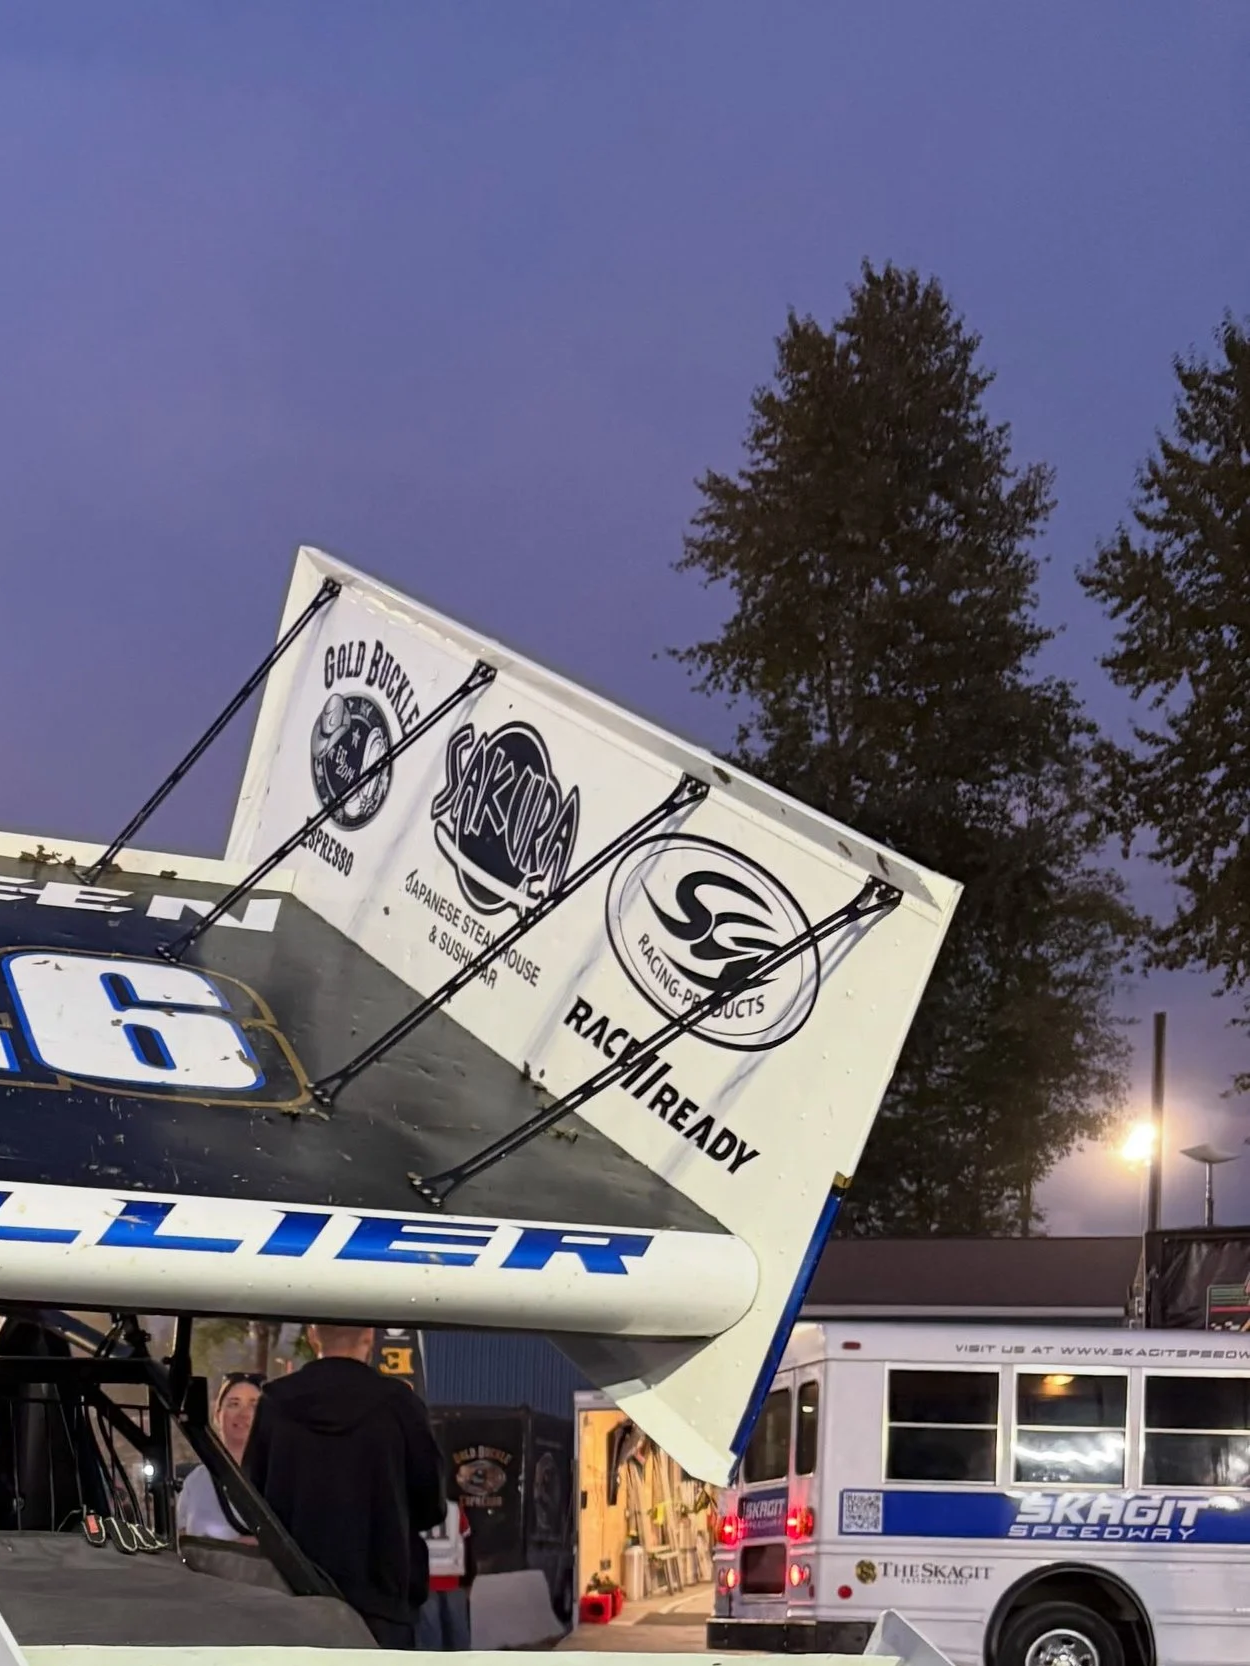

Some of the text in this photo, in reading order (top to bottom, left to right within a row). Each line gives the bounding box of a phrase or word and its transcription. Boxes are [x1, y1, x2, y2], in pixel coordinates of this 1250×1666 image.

[324, 639, 420, 738] GOLD BUCKLE
[431, 722, 581, 895] SAKURA
[405, 869, 462, 928] JAPANESE
[429, 925, 437, 945] &
[638, 933, 764, 1020] RACING-PRDUCTS
[955, 1344, 996, 1353] VISIT
[1001, 1345, 1026, 1354] US
[1031, 1346, 1054, 1354] AT
[1008, 1525, 1196, 1541] SPEEDWAY
[1017, 1497, 1207, 1527] SKAGIT
